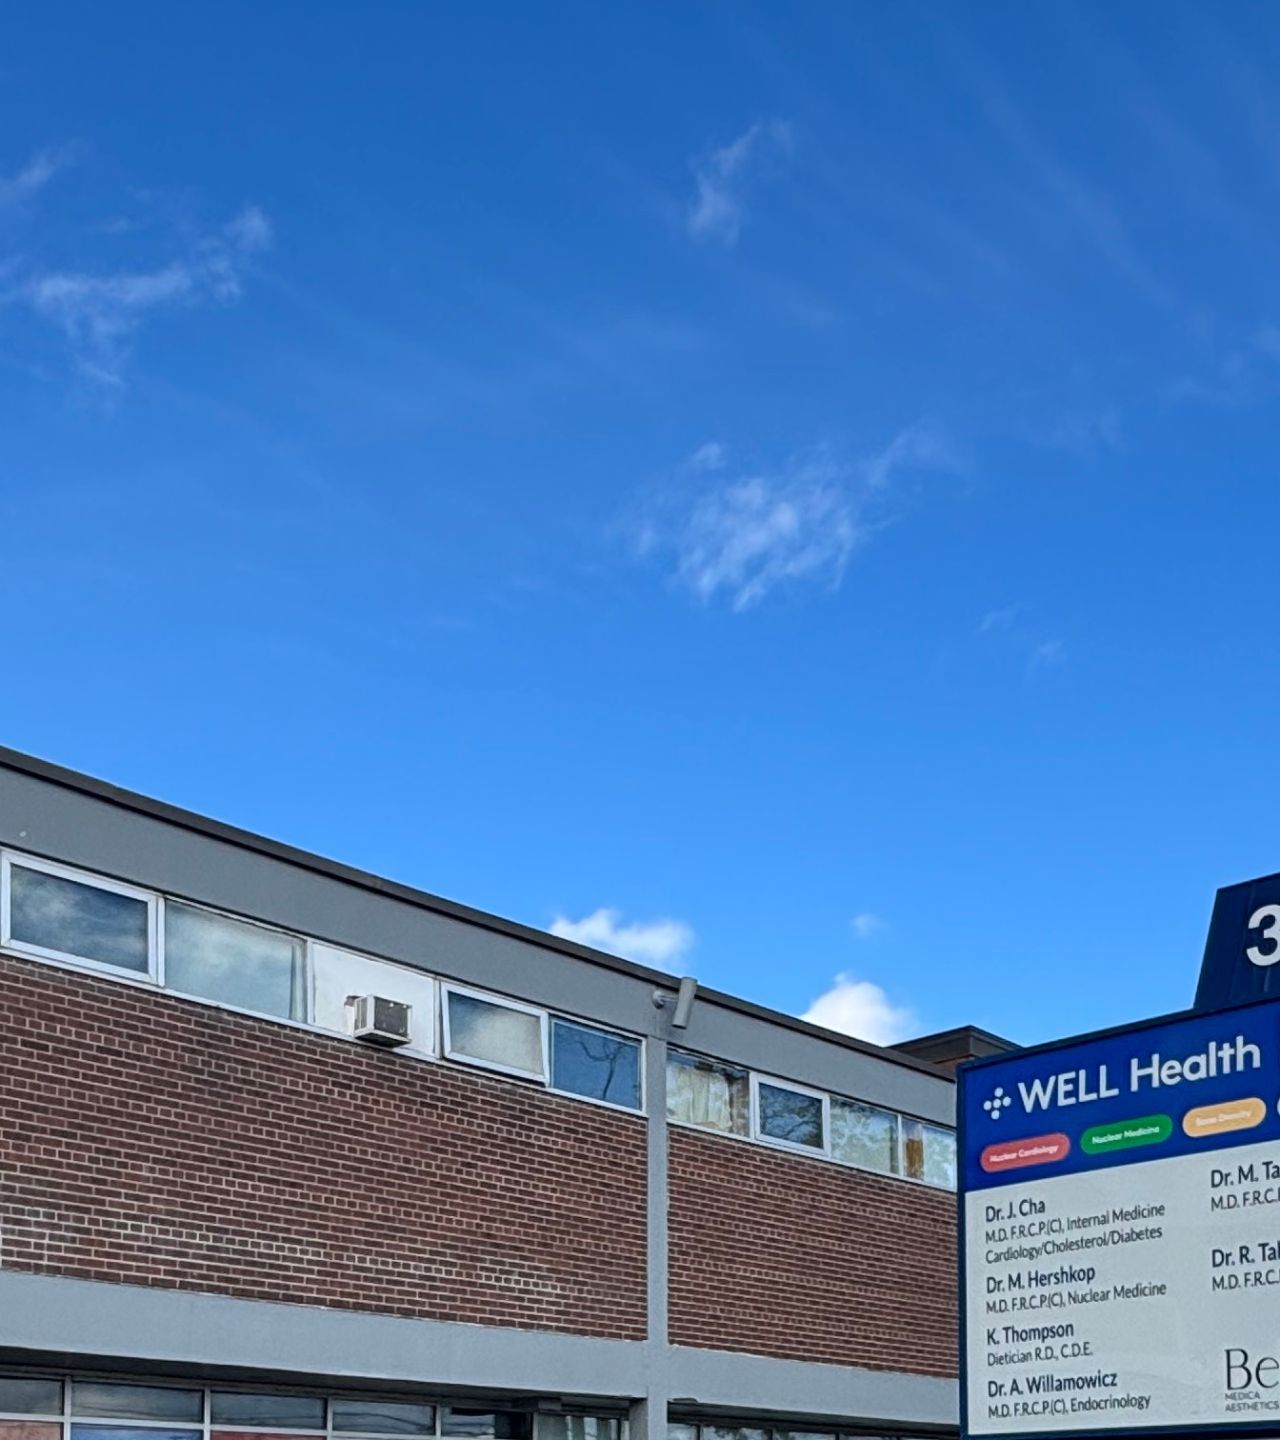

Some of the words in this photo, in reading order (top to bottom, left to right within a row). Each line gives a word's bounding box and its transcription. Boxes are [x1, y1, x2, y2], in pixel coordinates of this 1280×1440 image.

[1017, 1065, 1119, 1114] WELL
[1130, 1035, 1261, 1092] Health
[1210, 1169, 1234, 1188] Dr.
[1238, 1163, 1259, 1185] M.
[985, 1205, 1005, 1223] Dr.
[1007, 1202, 1017, 1219] J.
[1019, 1197, 1046, 1217] Cha
[1210, 1193, 1240, 1212] M.D.
[985, 1228, 1008, 1244] M.D.
[1067, 1209, 1109, 1231] Internal
[1112, 1203, 1166, 1224] Medicine
[985, 1226, 1163, 1264] Cardiology/Cholesterol/Diabetes
[1211, 1248, 1235, 1268] Dr.
[1239, 1245, 1255, 1265] R.
[986, 1276, 1005, 1294] Dr.
[1008, 1273, 1025, 1291] M.
[1028, 1264, 1096, 1288] Hershkop
[1211, 1274, 1241, 1291] M.D.
[986, 1300, 1010, 1314] M.D.
[1067, 1289, 1111, 1305] Nuclear
[1113, 1282, 1167, 1300] Medicine
[986, 1328, 1000, 1346] K.
[1002, 1323, 1074, 1344] Thompson
[987, 1350, 1033, 1367] Dietician
[1034, 1345, 1059, 1361] R.D.,
[1060, 1341, 1094, 1359] C.D.E.
[988, 1380, 1007, 1397] Dr.
[1009, 1378, 1024, 1396] A.
[1026, 1368, 1118, 1394] Willamowicz
[988, 1404, 1011, 1419] M.D.
[1070, 1393, 1152, 1413] Endocrinology
